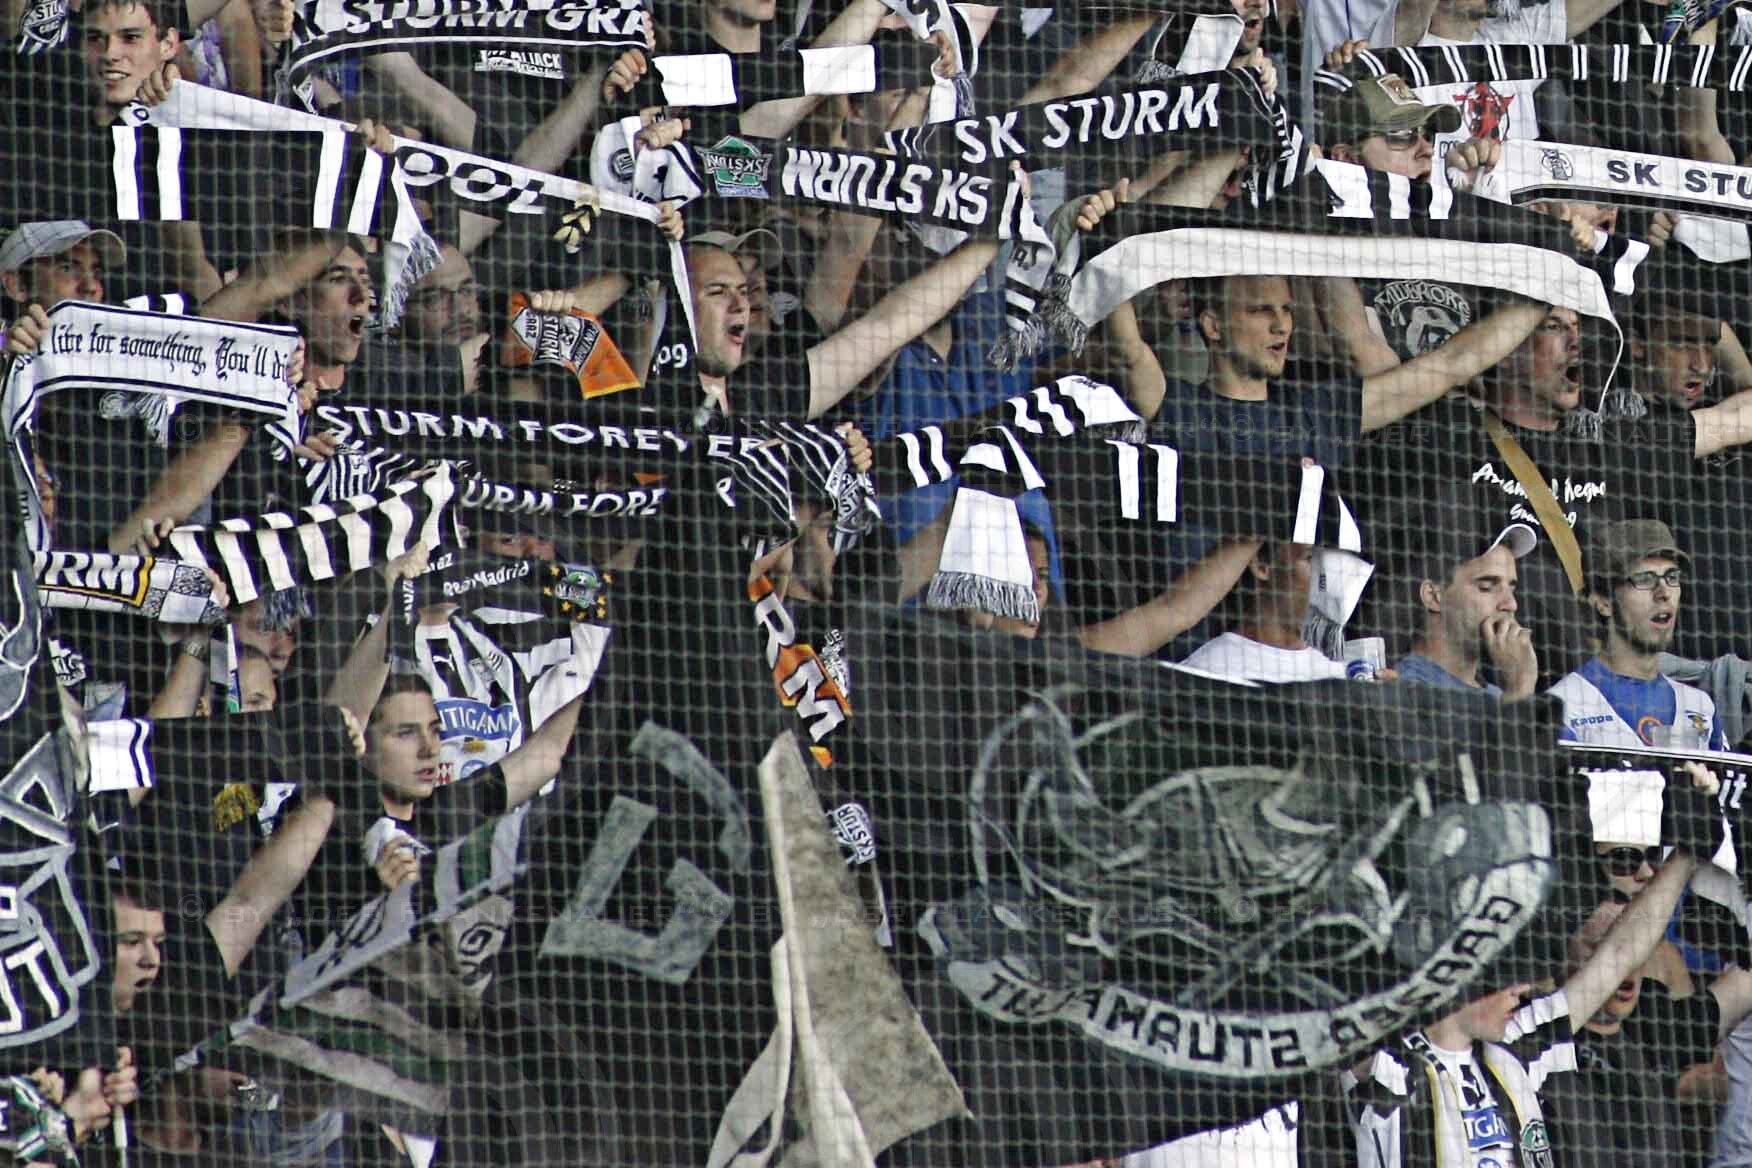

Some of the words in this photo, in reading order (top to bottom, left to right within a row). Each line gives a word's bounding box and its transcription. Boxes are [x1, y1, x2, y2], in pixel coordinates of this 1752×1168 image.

[955, 112, 1026, 163] SK
[1042, 82, 1221, 150] STURM
[781, 145, 929, 216] STURM
[931, 166, 994, 226] SK
[1606, 158, 1661, 188] SK
[88, 322, 115, 354] for
[119, 331, 207, 377] something,
[215, 336, 268, 381] You'll
[315, 405, 503, 439] STURM
[473, 560, 530, 590] Madrid
[1570, 714, 1615, 728] Kappa
